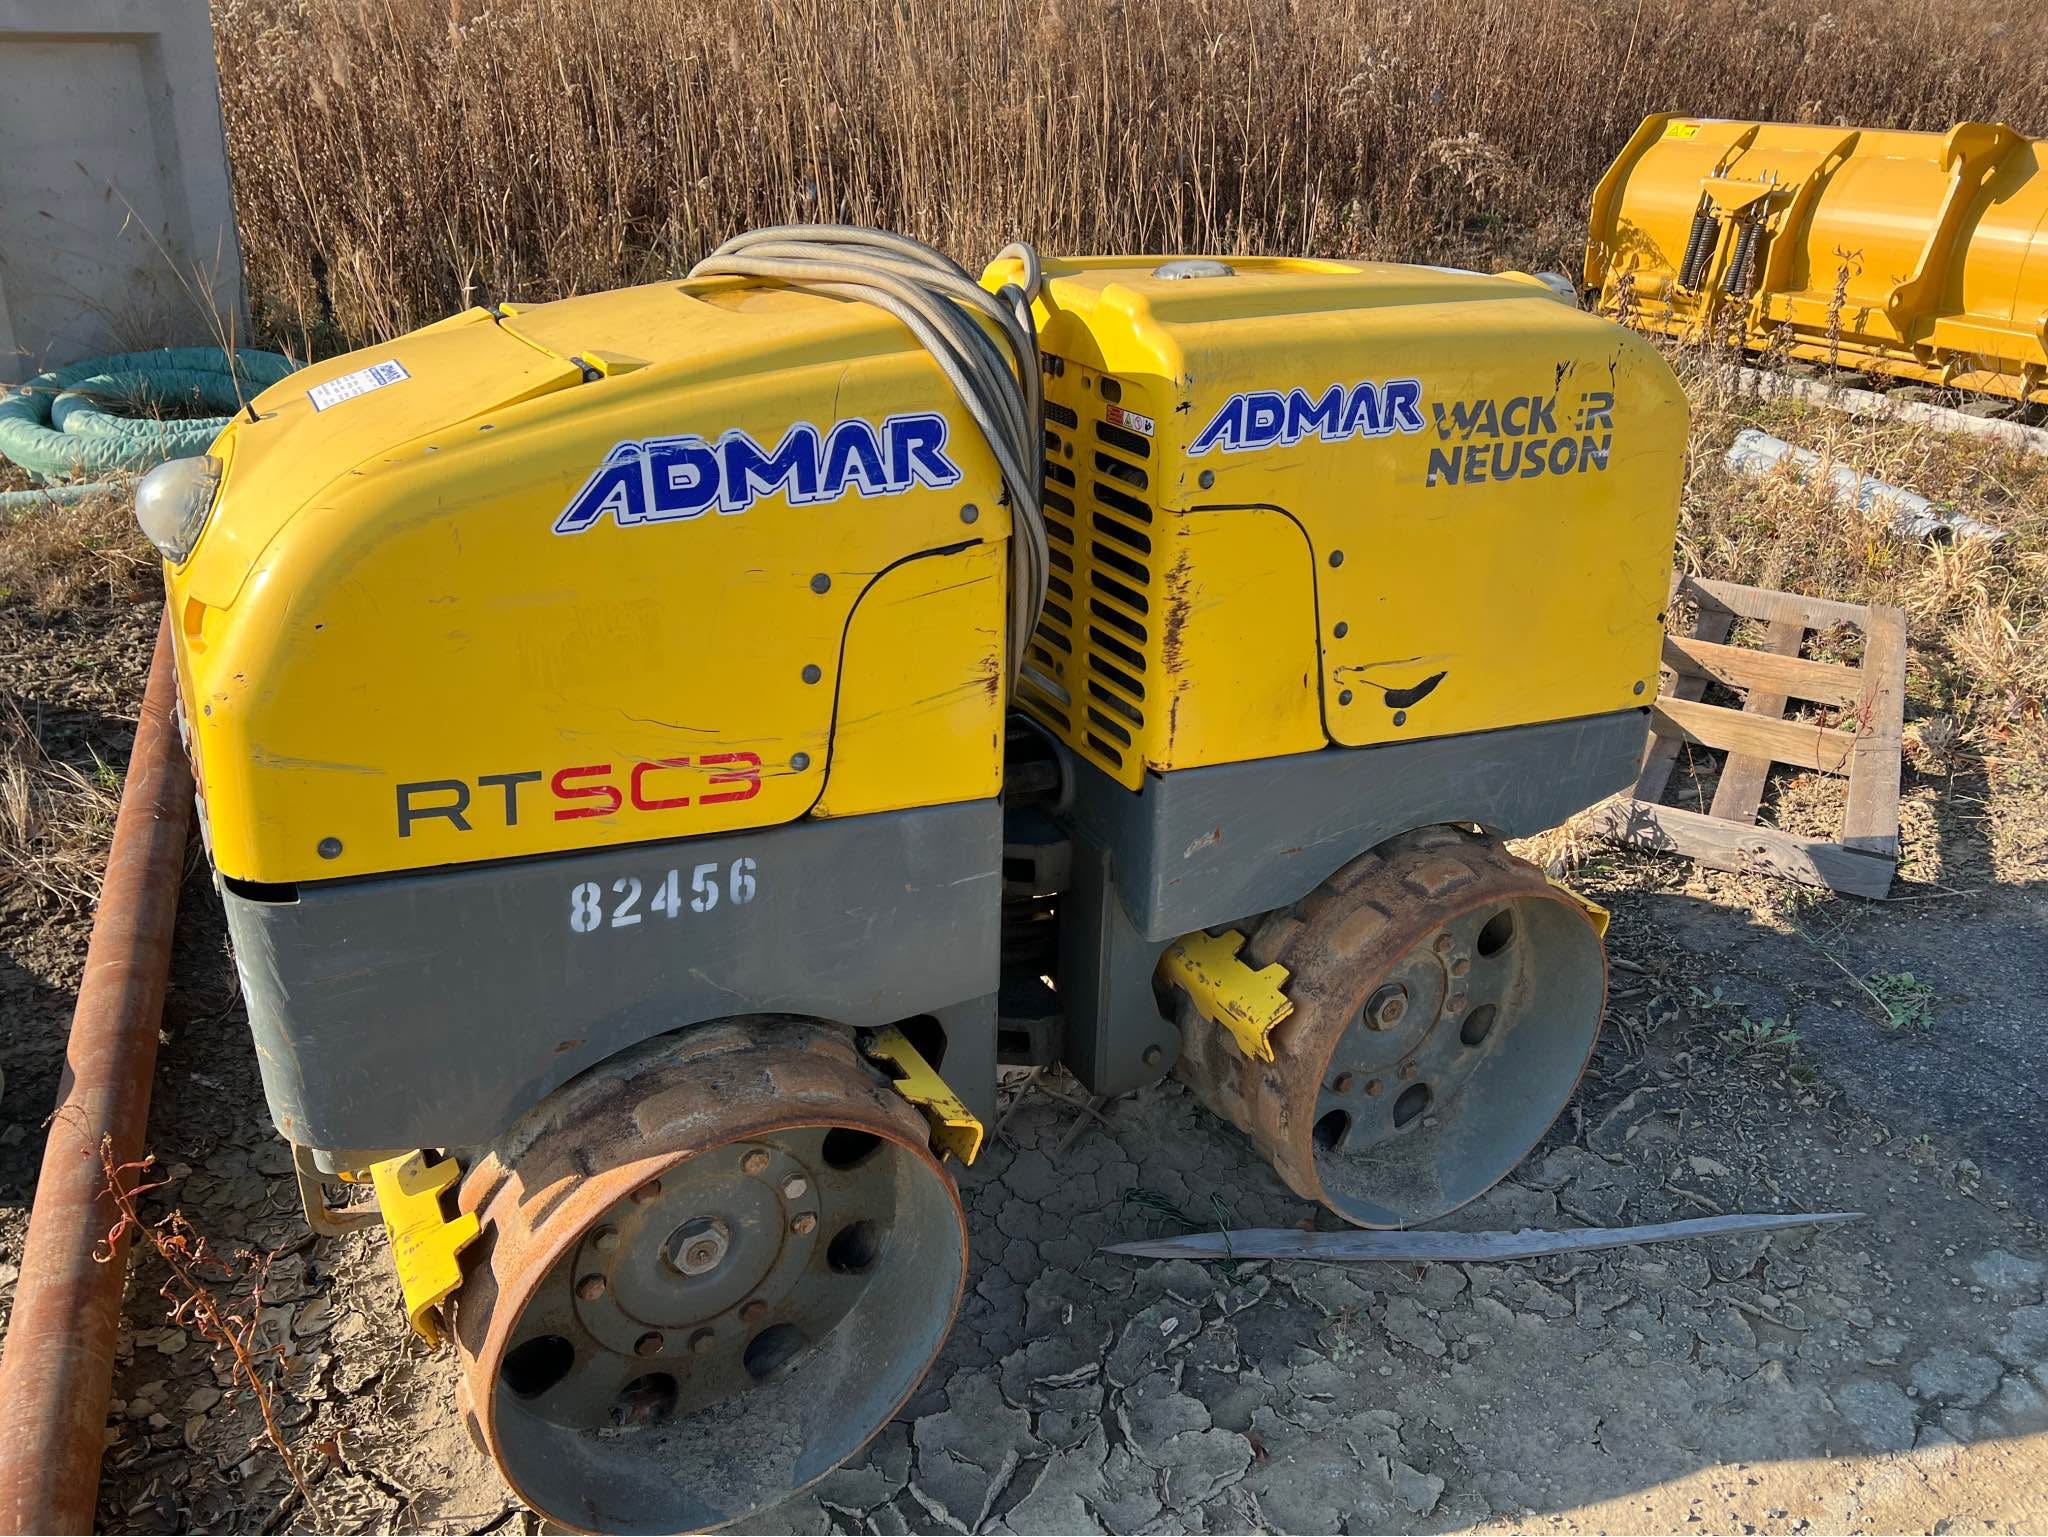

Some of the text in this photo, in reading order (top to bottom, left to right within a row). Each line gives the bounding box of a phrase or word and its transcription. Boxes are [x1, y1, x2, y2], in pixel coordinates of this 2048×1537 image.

[1187, 378, 1424, 456] ADMAR
[553, 413, 961, 533] ADMAR
[1426, 434, 1612, 488] NEUSON
[570, 857, 758, 932] 82456
